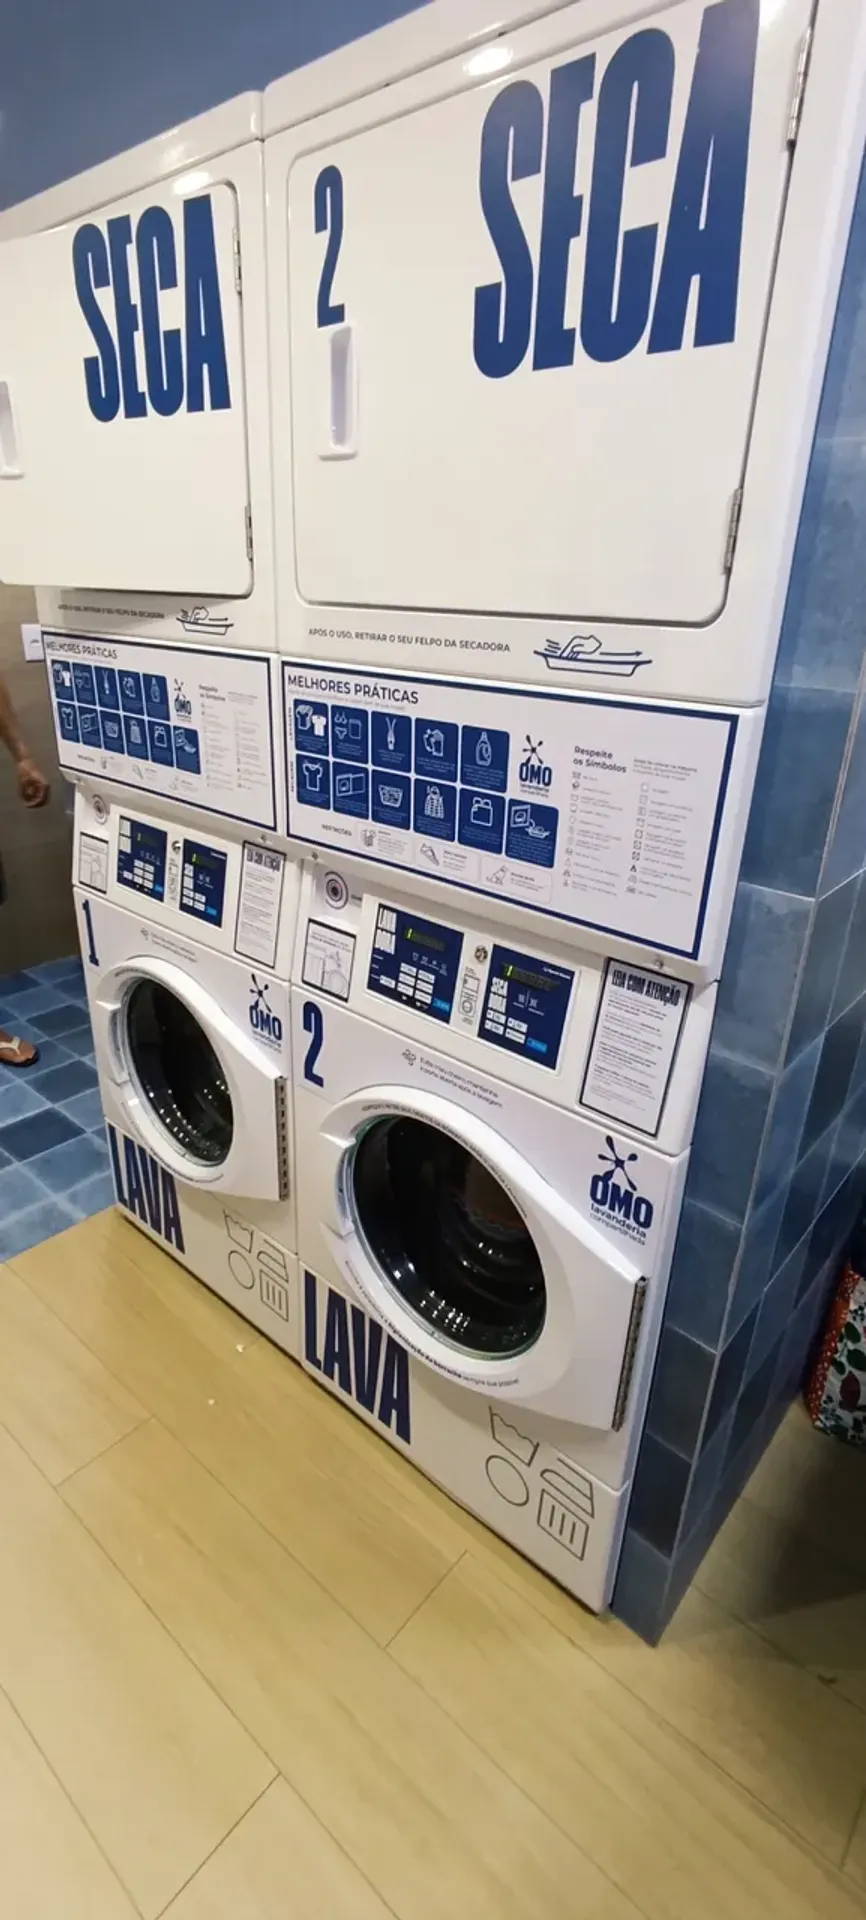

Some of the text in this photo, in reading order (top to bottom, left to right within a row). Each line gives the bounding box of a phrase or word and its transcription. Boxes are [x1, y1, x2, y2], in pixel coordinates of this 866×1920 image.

[473, 0, 760, 379] SECA
[314, 165, 346, 329] 2
[72, 196, 231, 423] SECA
[46, 642, 81, 654] MELHORES
[82, 643, 117, 659] PRÁTICAS
[309, 628, 328, 637] APÓS
[355, 632, 386, 641] RETIRAR
[389, 635, 395, 643] O
[398, 636, 413, 644] SEU
[415, 637, 442, 646] FELPO
[444, 640, 456, 648] DA
[459, 640, 510, 652] SECADORA
[175, 696, 191, 715] OMO
[288, 675, 351, 694] MELHORES
[354, 683, 419, 704] PRÁTICAS
[574, 746, 613, 760] Respeite
[585, 759, 627, 773] Símbolos
[519, 762, 552, 787] OMO
[82, 899, 99, 966] 1
[612, 969, 681, 1007] LEIA COM ATENÇÃO
[250, 1005, 282, 1040] OMO
[303, 1000, 324, 1088] 2
[108, 1124, 186, 1255] LAVA
[590, 1169, 653, 1229] OMO
[590, 1204, 646, 1238] lavanderia
[304, 1269, 411, 1445] LAVA
